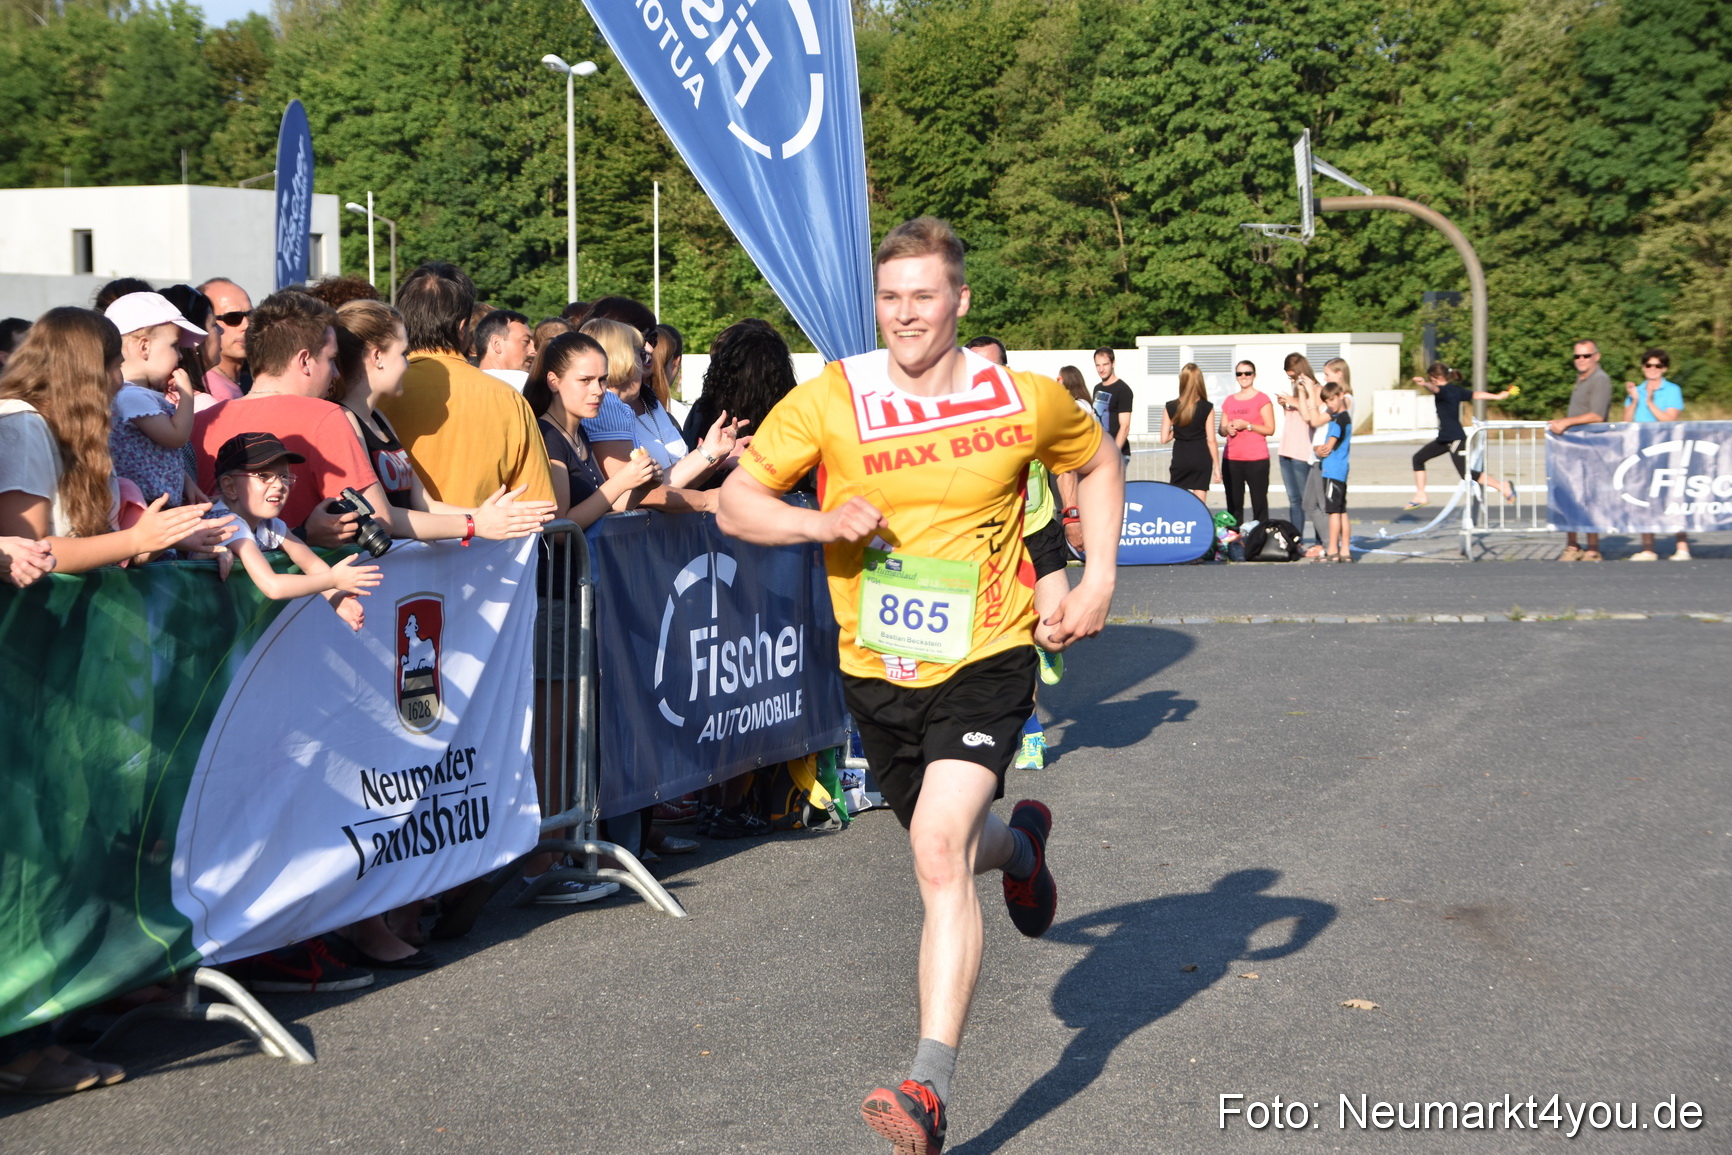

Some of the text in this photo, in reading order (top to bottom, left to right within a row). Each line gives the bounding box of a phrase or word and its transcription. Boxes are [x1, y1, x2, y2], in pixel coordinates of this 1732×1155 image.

[862, 424, 1033, 475] MAX BÖGL
[1121, 516, 1197, 536] ischer
[1118, 536, 1191, 546] AUTOMOBILE
[879, 593, 949, 634] 865
[880, 631, 906, 642] Bastian
[906, 637, 942, 648] Beckstein
[407, 699, 432, 721] 1628
[696, 689, 803, 744] AUTOMOBILE
